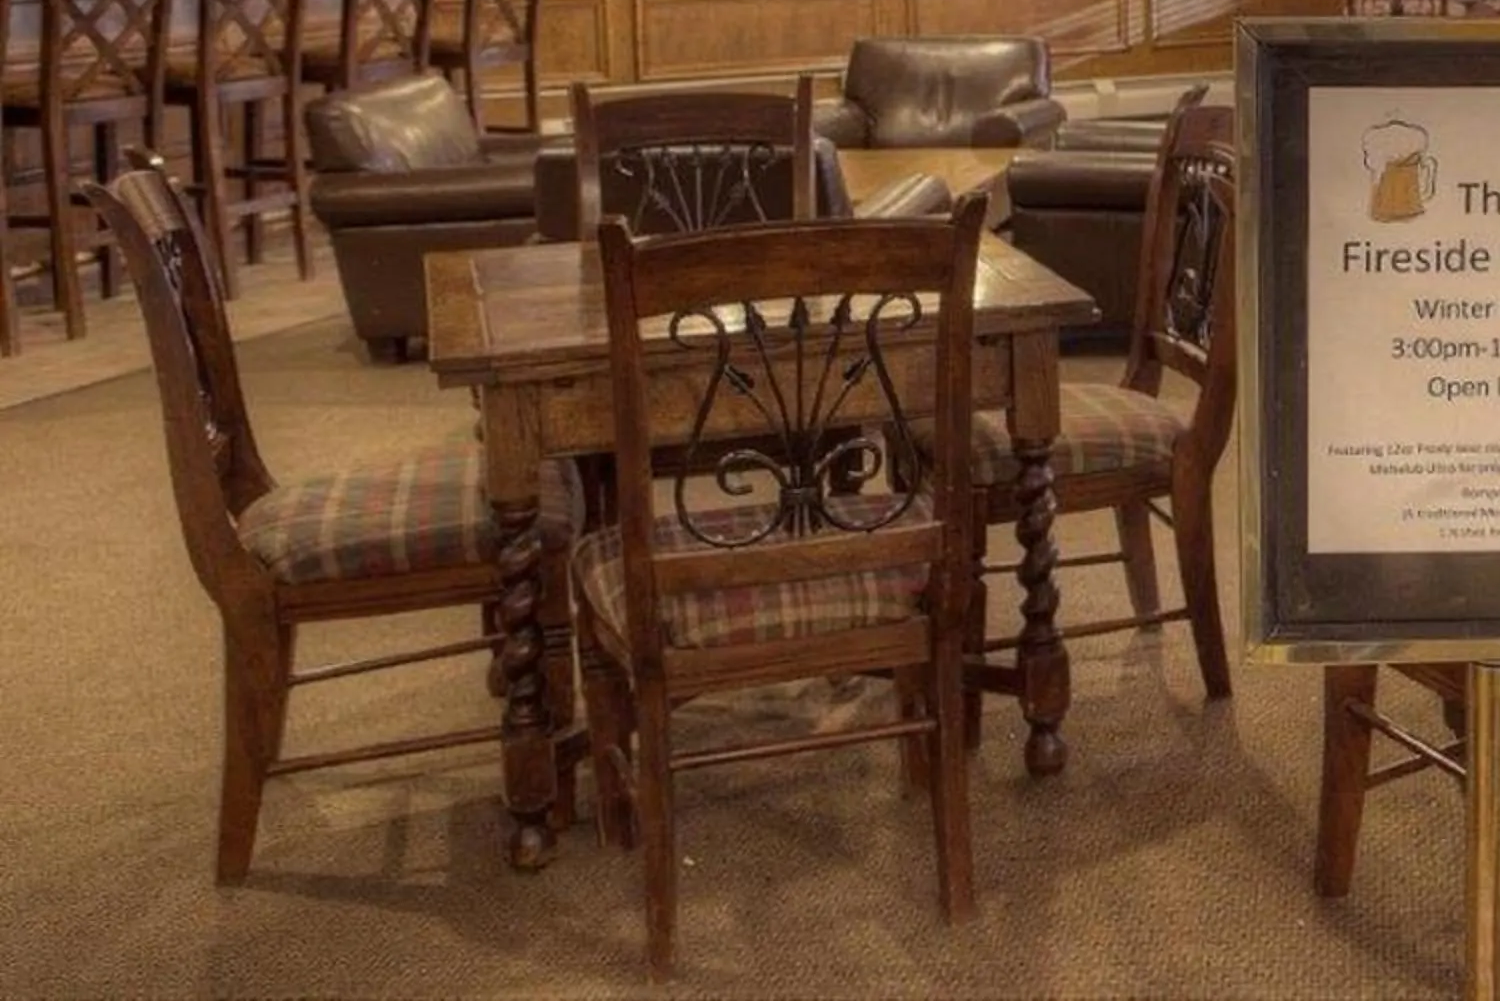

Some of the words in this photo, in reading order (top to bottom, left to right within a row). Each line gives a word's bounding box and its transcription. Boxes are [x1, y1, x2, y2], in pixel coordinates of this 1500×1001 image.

[1343, 240, 1491, 273] Fireside
[1414, 299, 1493, 320] Winter
[1427, 376, 1489, 400] Open
